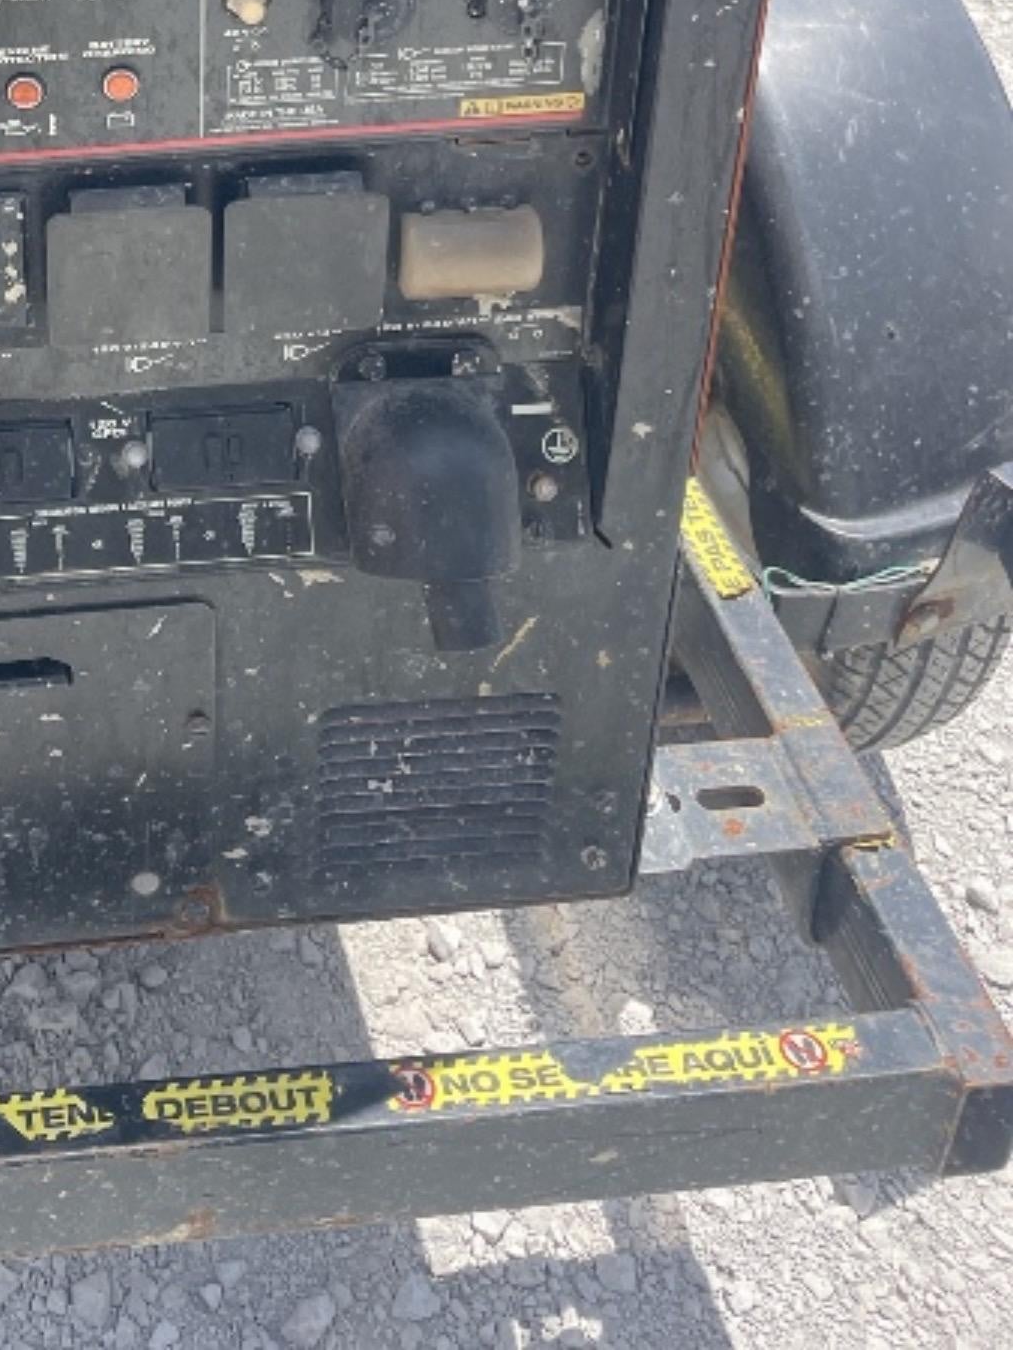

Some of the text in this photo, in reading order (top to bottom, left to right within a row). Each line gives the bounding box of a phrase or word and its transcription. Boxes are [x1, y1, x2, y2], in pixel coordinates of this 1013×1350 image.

[441, 1070, 501, 1096] NO
[508, 1064, 560, 1089] SE
[155, 1087, 319, 1120] DEBOUT
